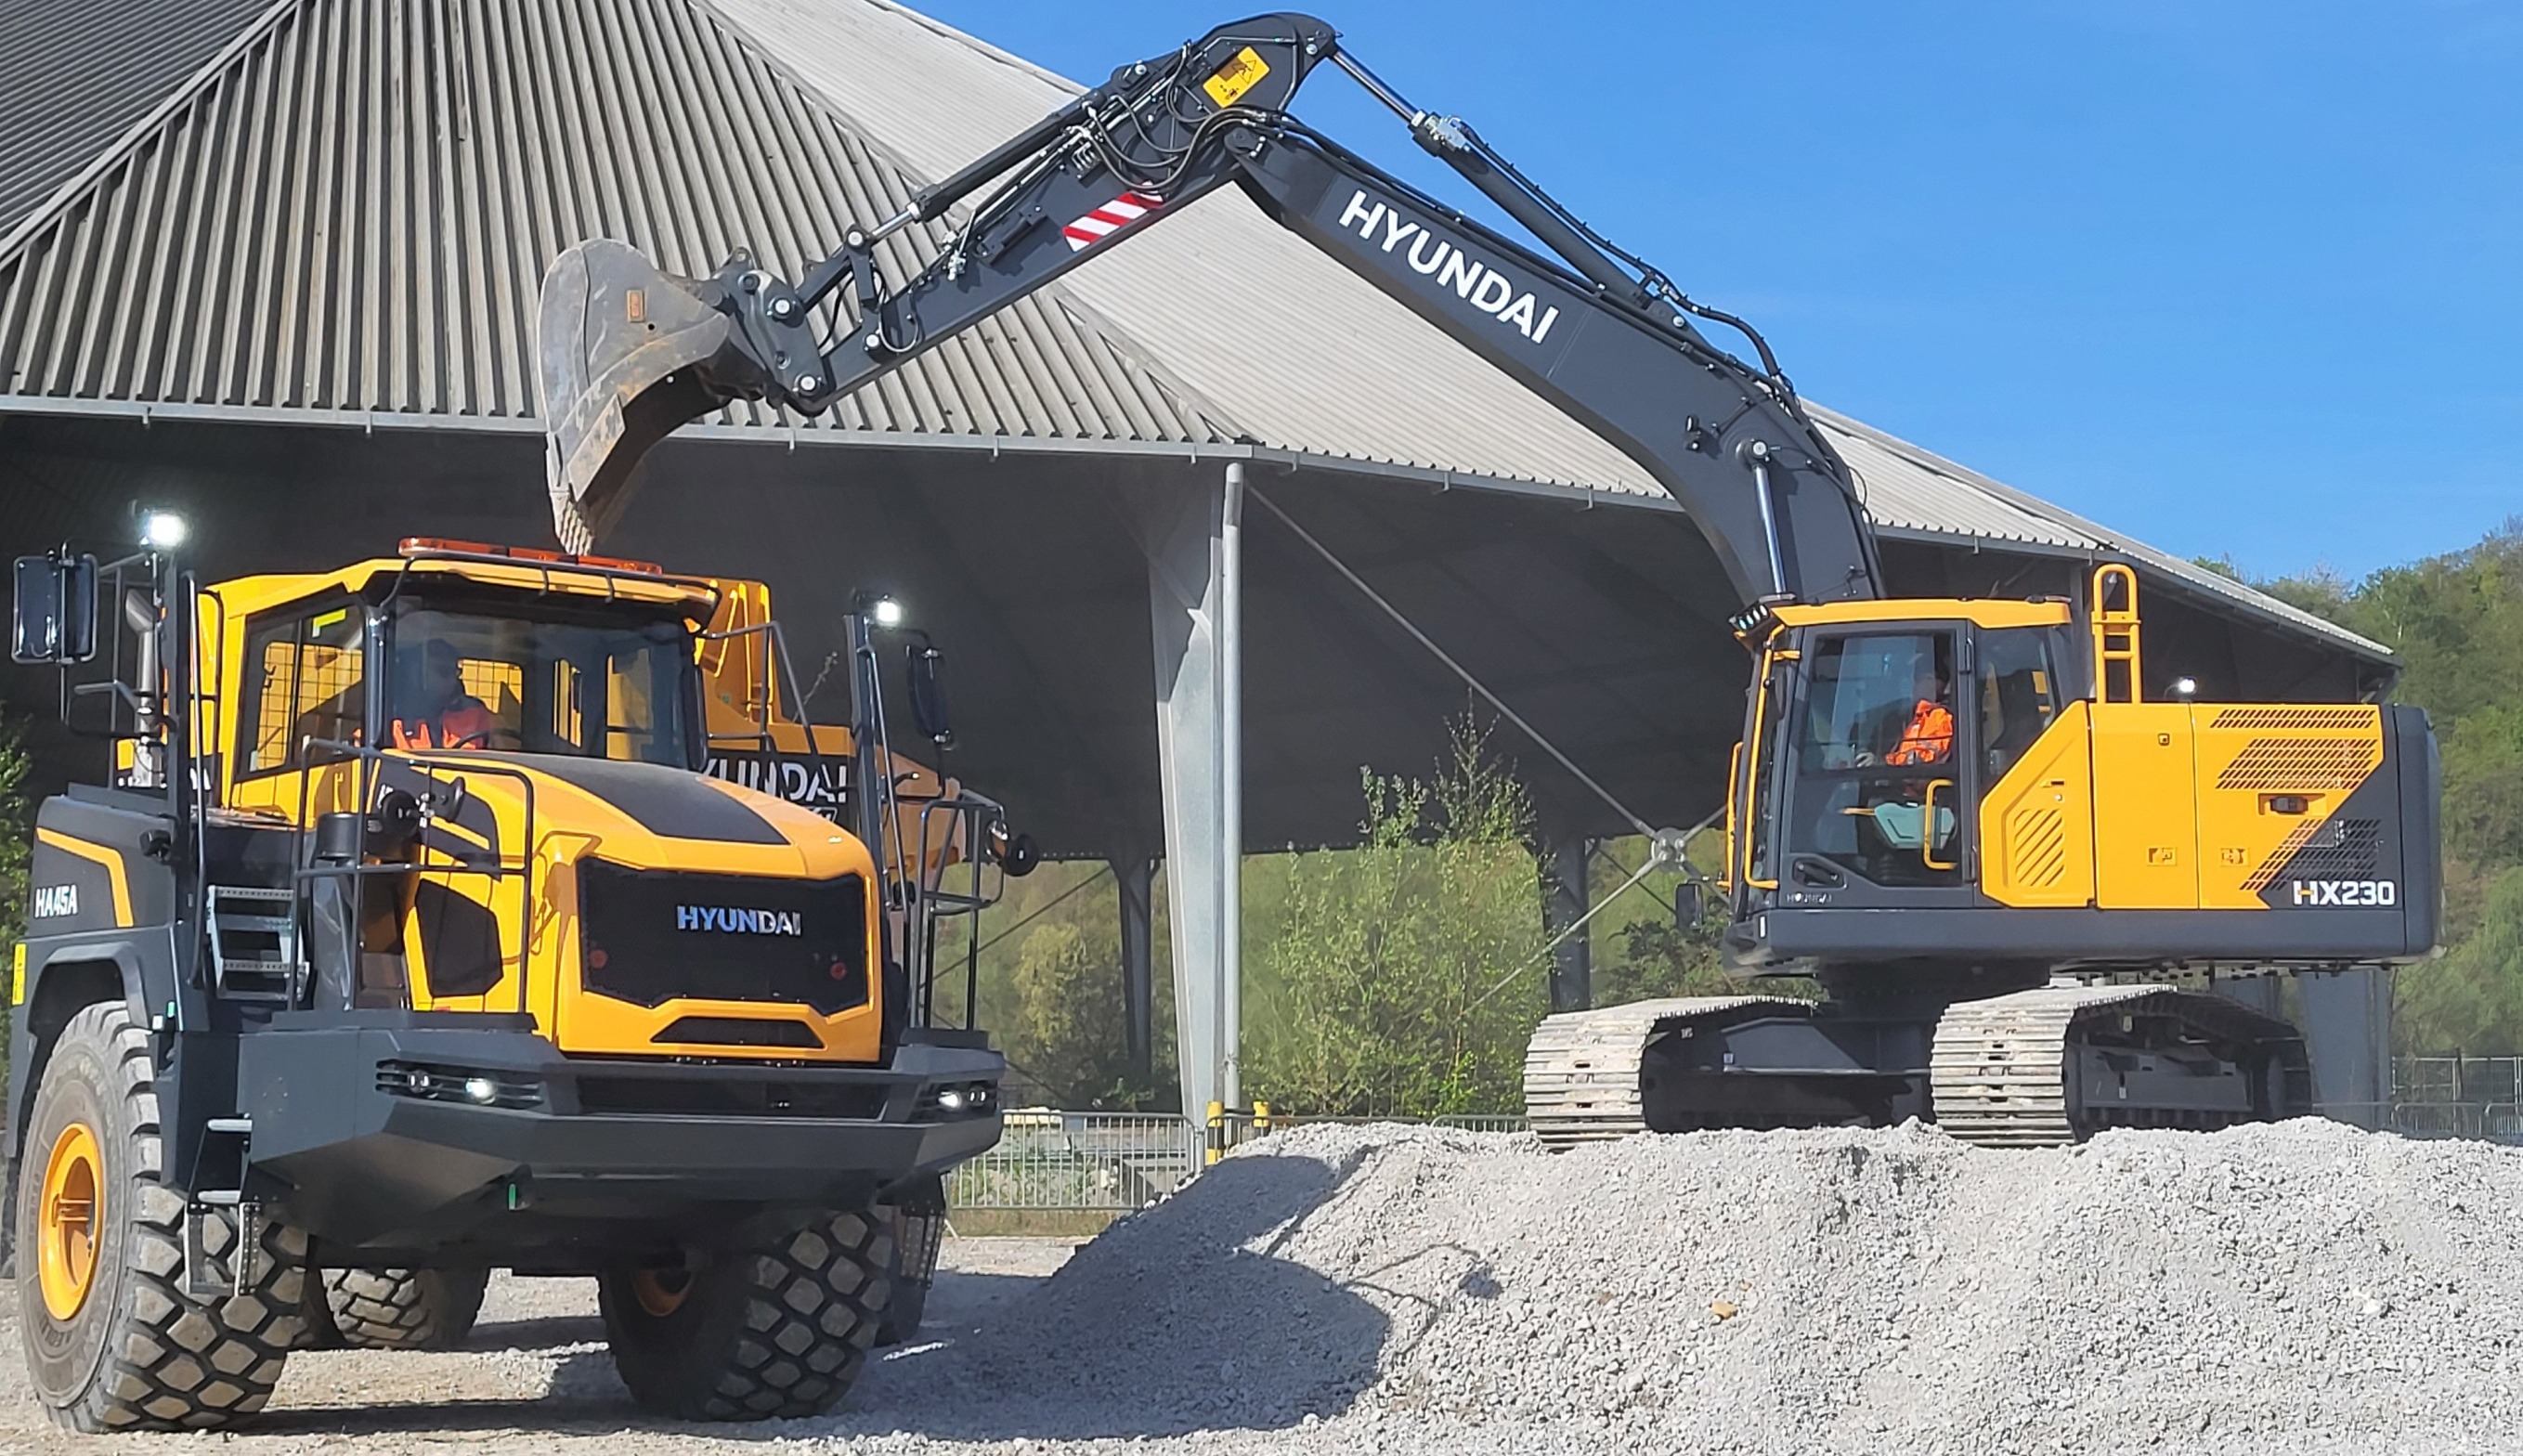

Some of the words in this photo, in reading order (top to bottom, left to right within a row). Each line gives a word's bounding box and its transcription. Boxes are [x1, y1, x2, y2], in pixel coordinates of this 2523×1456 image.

[1338, 188, 1560, 344] HYUNDAI
[34, 884, 78, 918] HA45A
[2293, 880, 2396, 905] HX230
[677, 905, 801, 936] HYUNDAI
